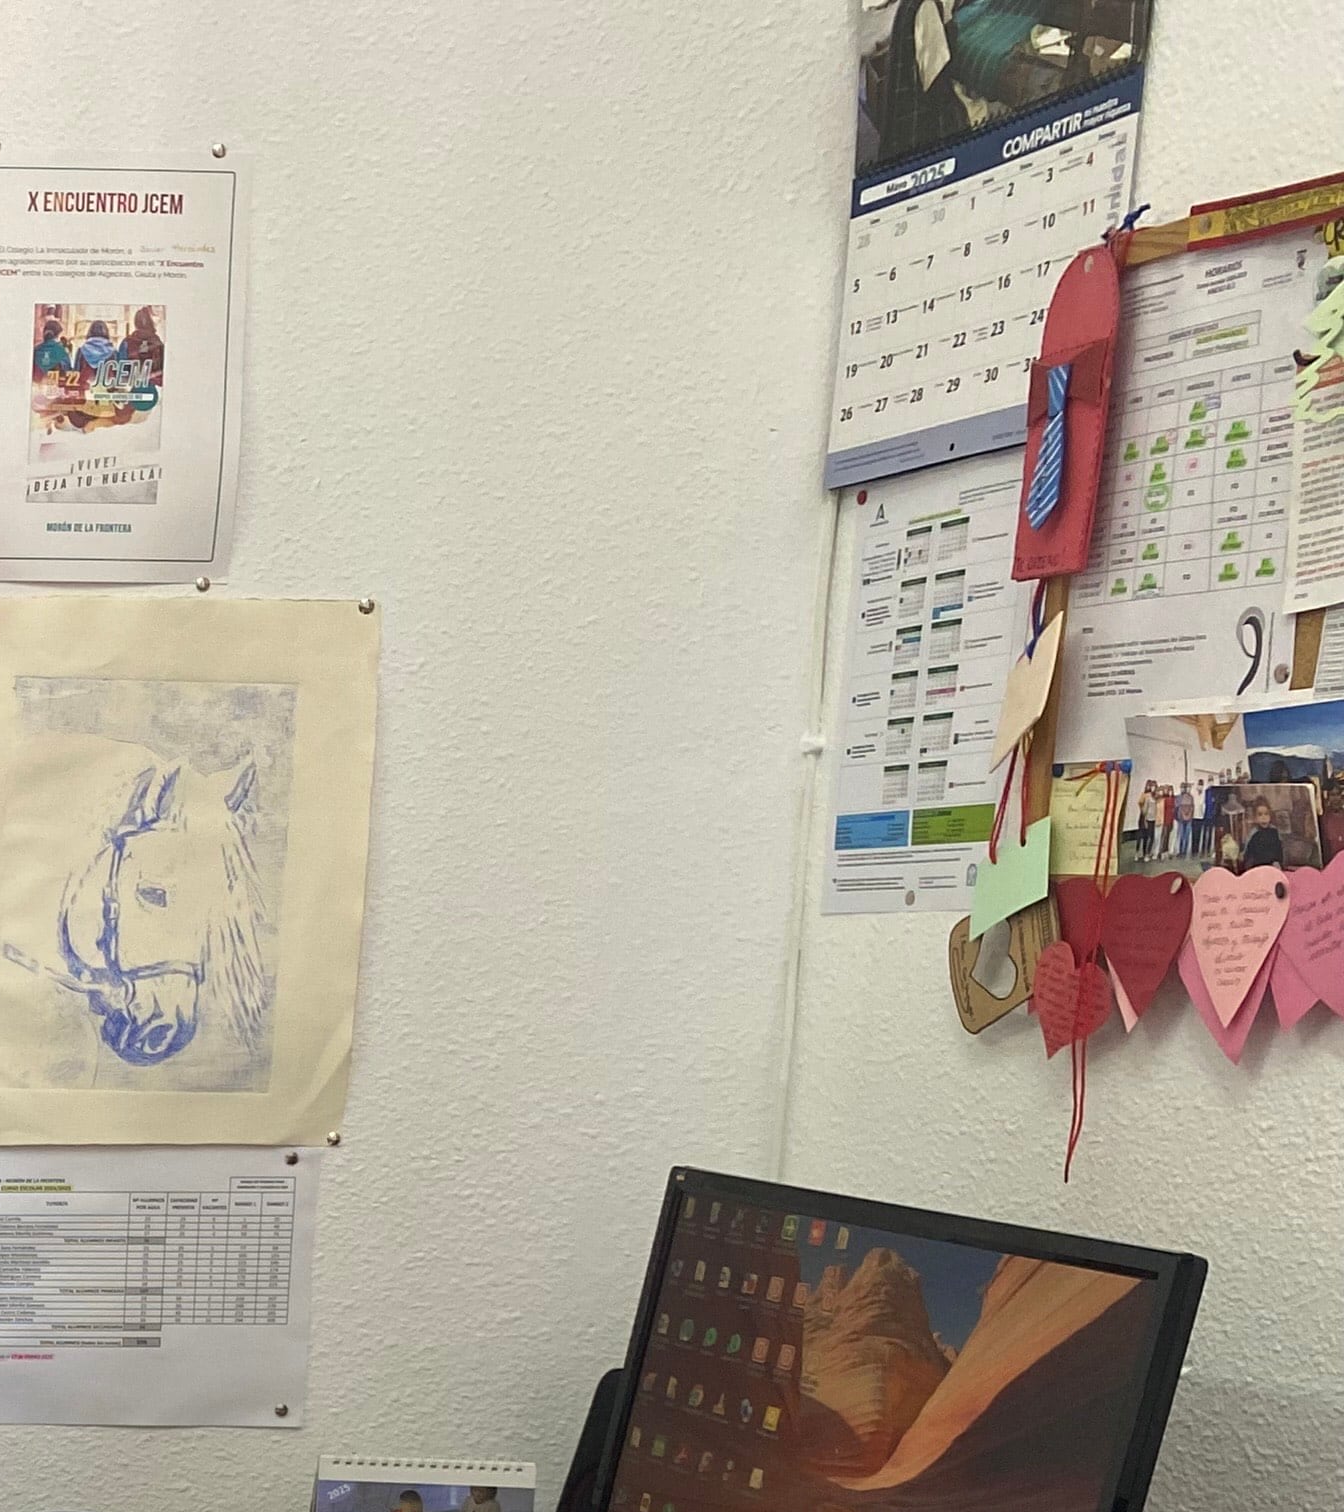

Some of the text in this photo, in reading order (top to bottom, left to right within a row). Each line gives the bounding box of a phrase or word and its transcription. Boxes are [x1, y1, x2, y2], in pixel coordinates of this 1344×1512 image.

[1002, 112, 1083, 158] COMPARTIR
[886, 181, 908, 194] Mayo
[28, 192, 183, 215] X ENCUENTRO JCEM
[851, 262, 1050, 335] 12 13 14 15 16 17
[94, 359, 152, 388] JCEM
[840, 367, 998, 421] 26 27 28 29 30
[70, 457, 116, 474] ¡VIVE!
[27, 479, 67, 496] ¡DEJA
[103, 468, 162, 484] HUELLA!
